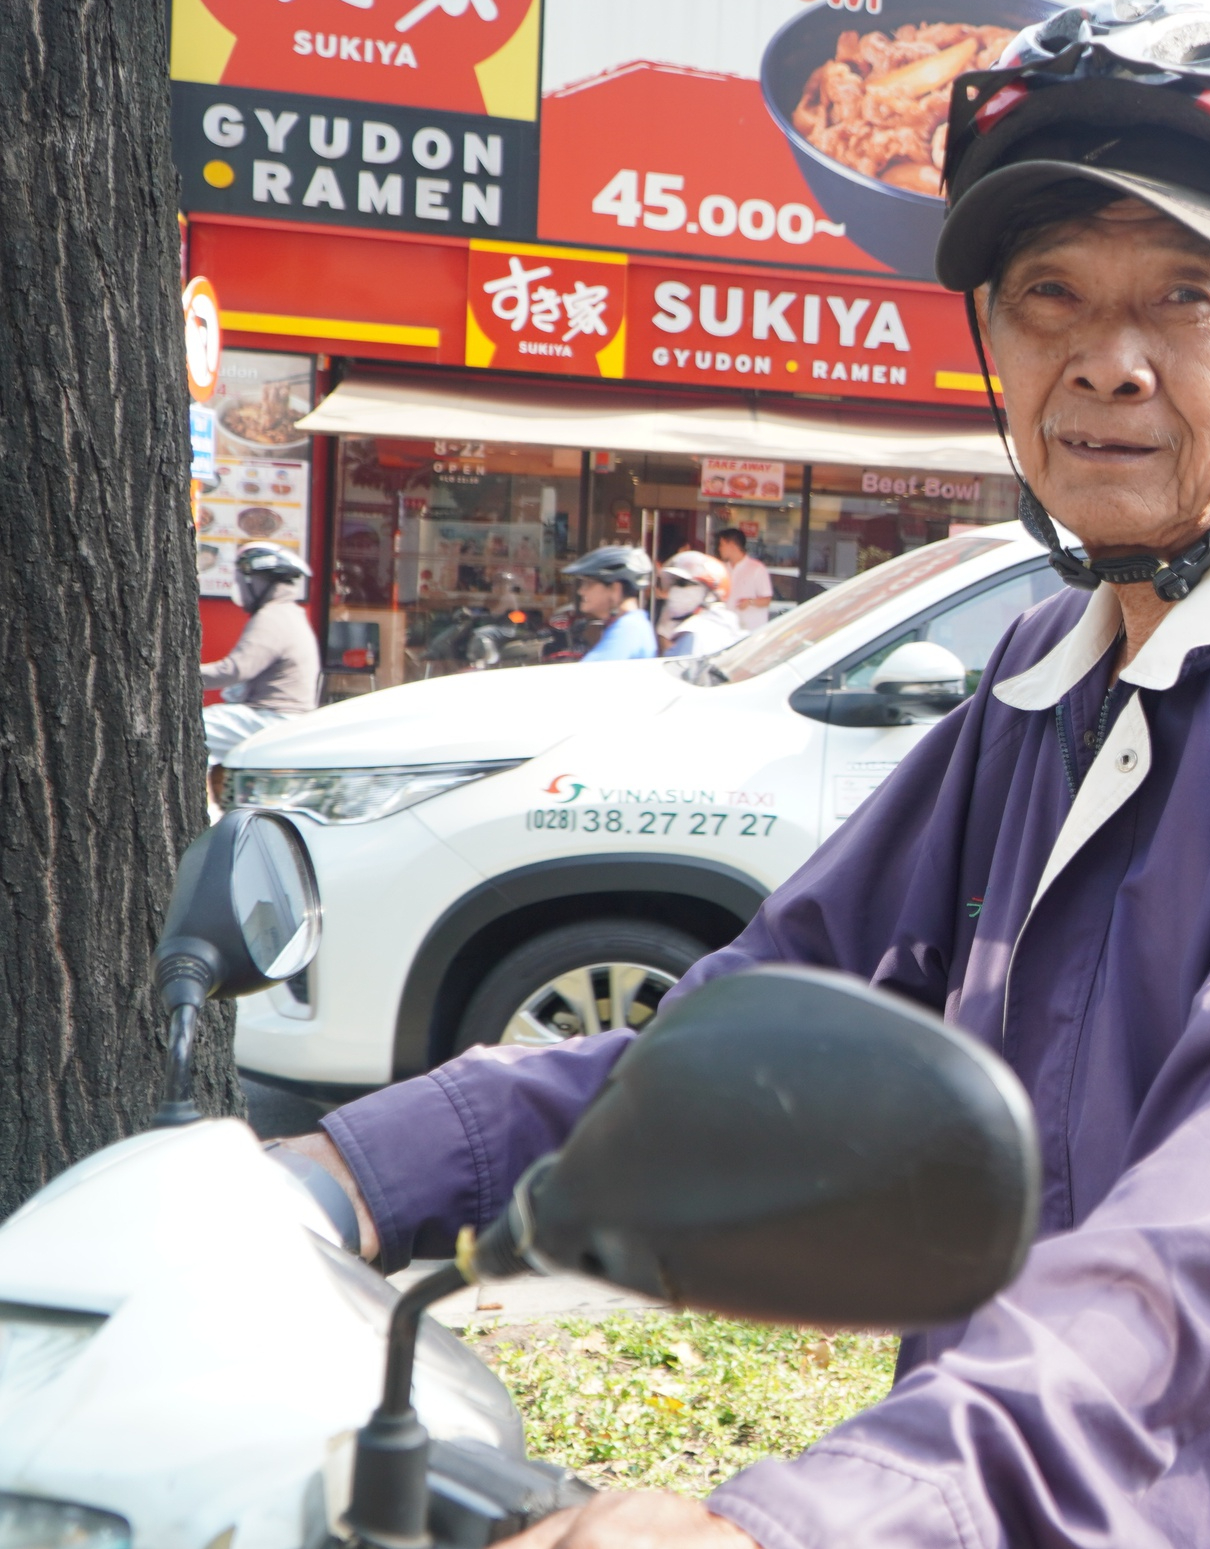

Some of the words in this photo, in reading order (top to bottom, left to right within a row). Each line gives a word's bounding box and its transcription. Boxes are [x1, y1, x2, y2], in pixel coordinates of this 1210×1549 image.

[293, 30, 418, 69] SUKIYA
[202, 103, 502, 177] GYUDON
[251, 159, 501, 227] RAMEN
[482, 256, 609, 343] すき家
[652, 279, 910, 352] SUKIYA
[518, 340, 573, 359] SUKIYA
[652, 346, 772, 375] GYUDON
[812, 359, 907, 386] RAMEN
[433, 460, 486, 476] OPEN
[707, 460, 737, 471] TAKE
[741, 462, 772, 472] AWAY
[861, 472, 918, 496] Beef
[924, 476, 981, 500] Bowl
[598, 787, 715, 804] VINASUN
[726, 790, 775, 807] TAXI
[525, 808, 578, 832] (028)
[690, 811, 729, 836] 27
[739, 813, 779, 837] 27
